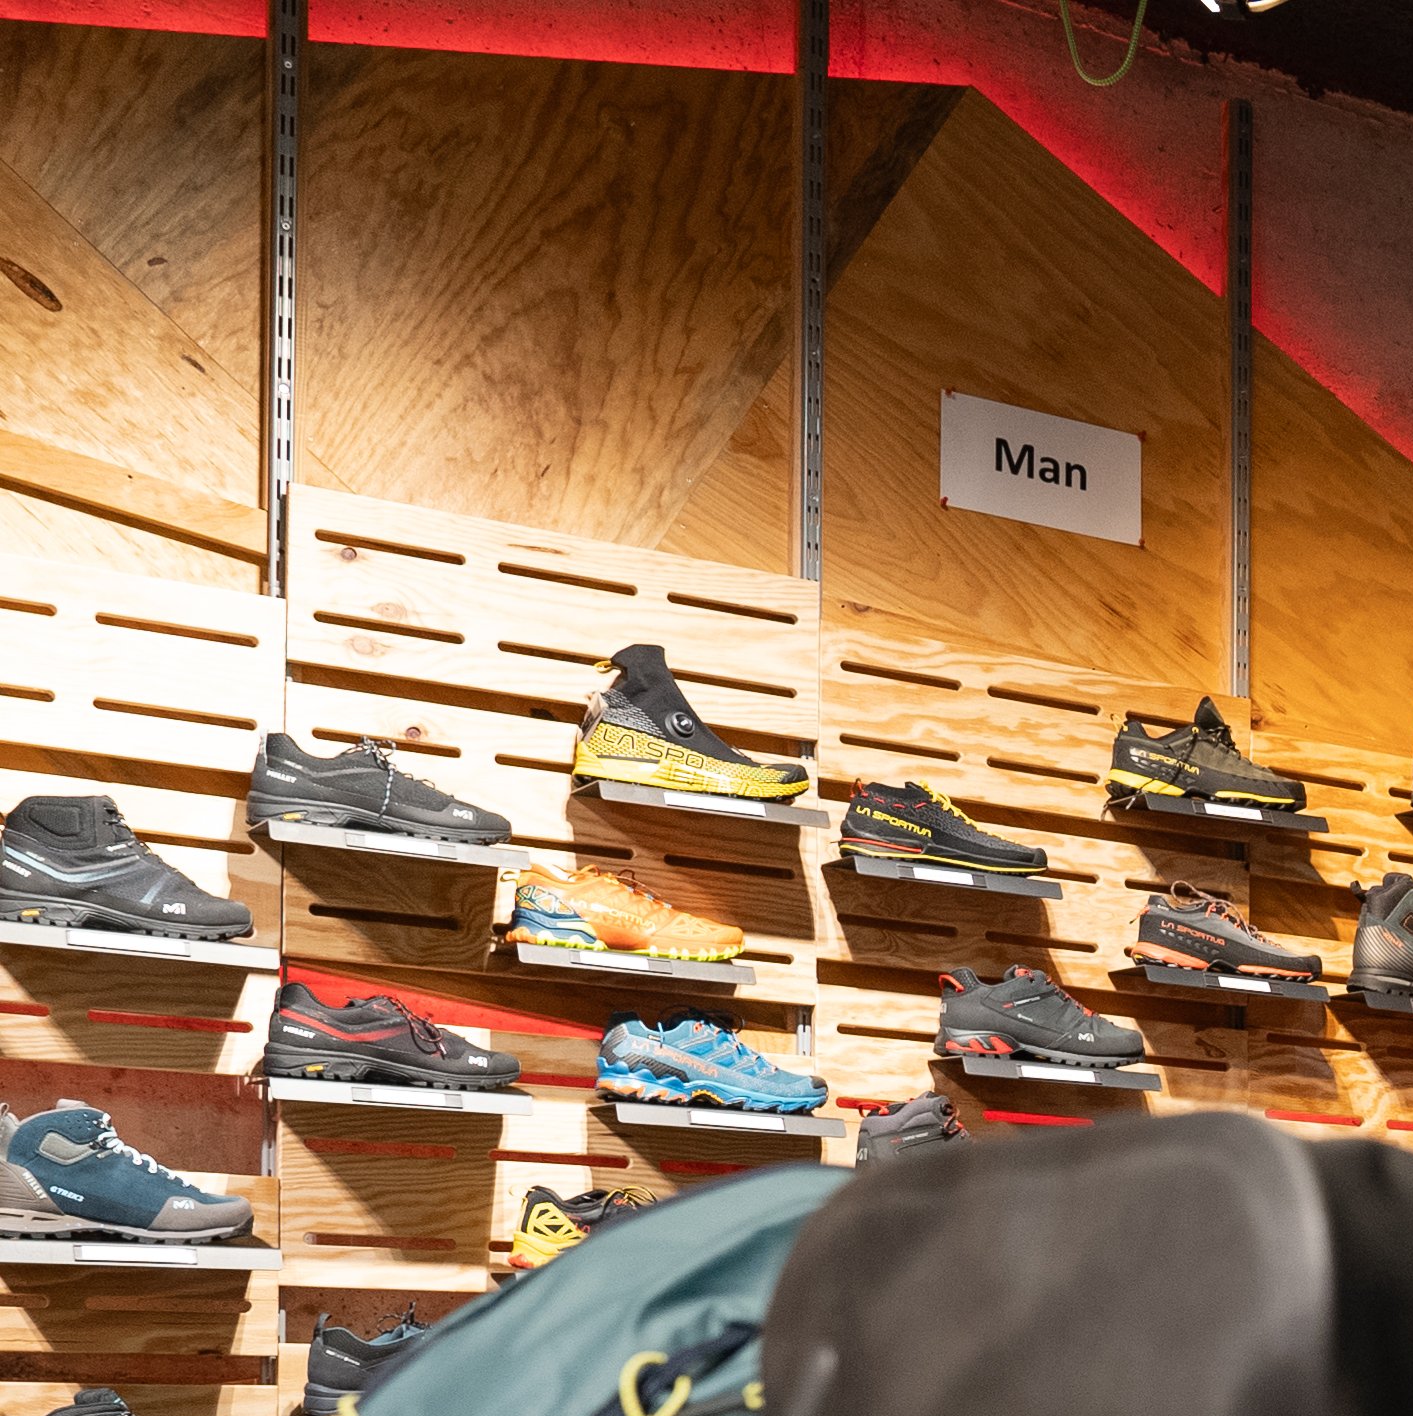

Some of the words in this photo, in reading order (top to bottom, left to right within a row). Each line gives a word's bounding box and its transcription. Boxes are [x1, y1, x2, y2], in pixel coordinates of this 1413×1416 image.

[994, 437, 1088, 491] Man
[603, 728, 635, 749] LA
[266, 769, 297, 784] MILLET
[1148, 752, 1200, 776] SPORTIVA
[856, 805, 870, 818] LA
[872, 810, 933, 838] SPORTIVA
[590, 902, 657, 935] SPORTIVA
[1160, 919, 1175, 930] LA
[1177, 924, 1227, 947] SPORTIVA
[283, 1025, 316, 1039] MILLET
[653, 1044, 719, 1079] SPORTIVA
[20, 1171, 48, 1200] MILLET
